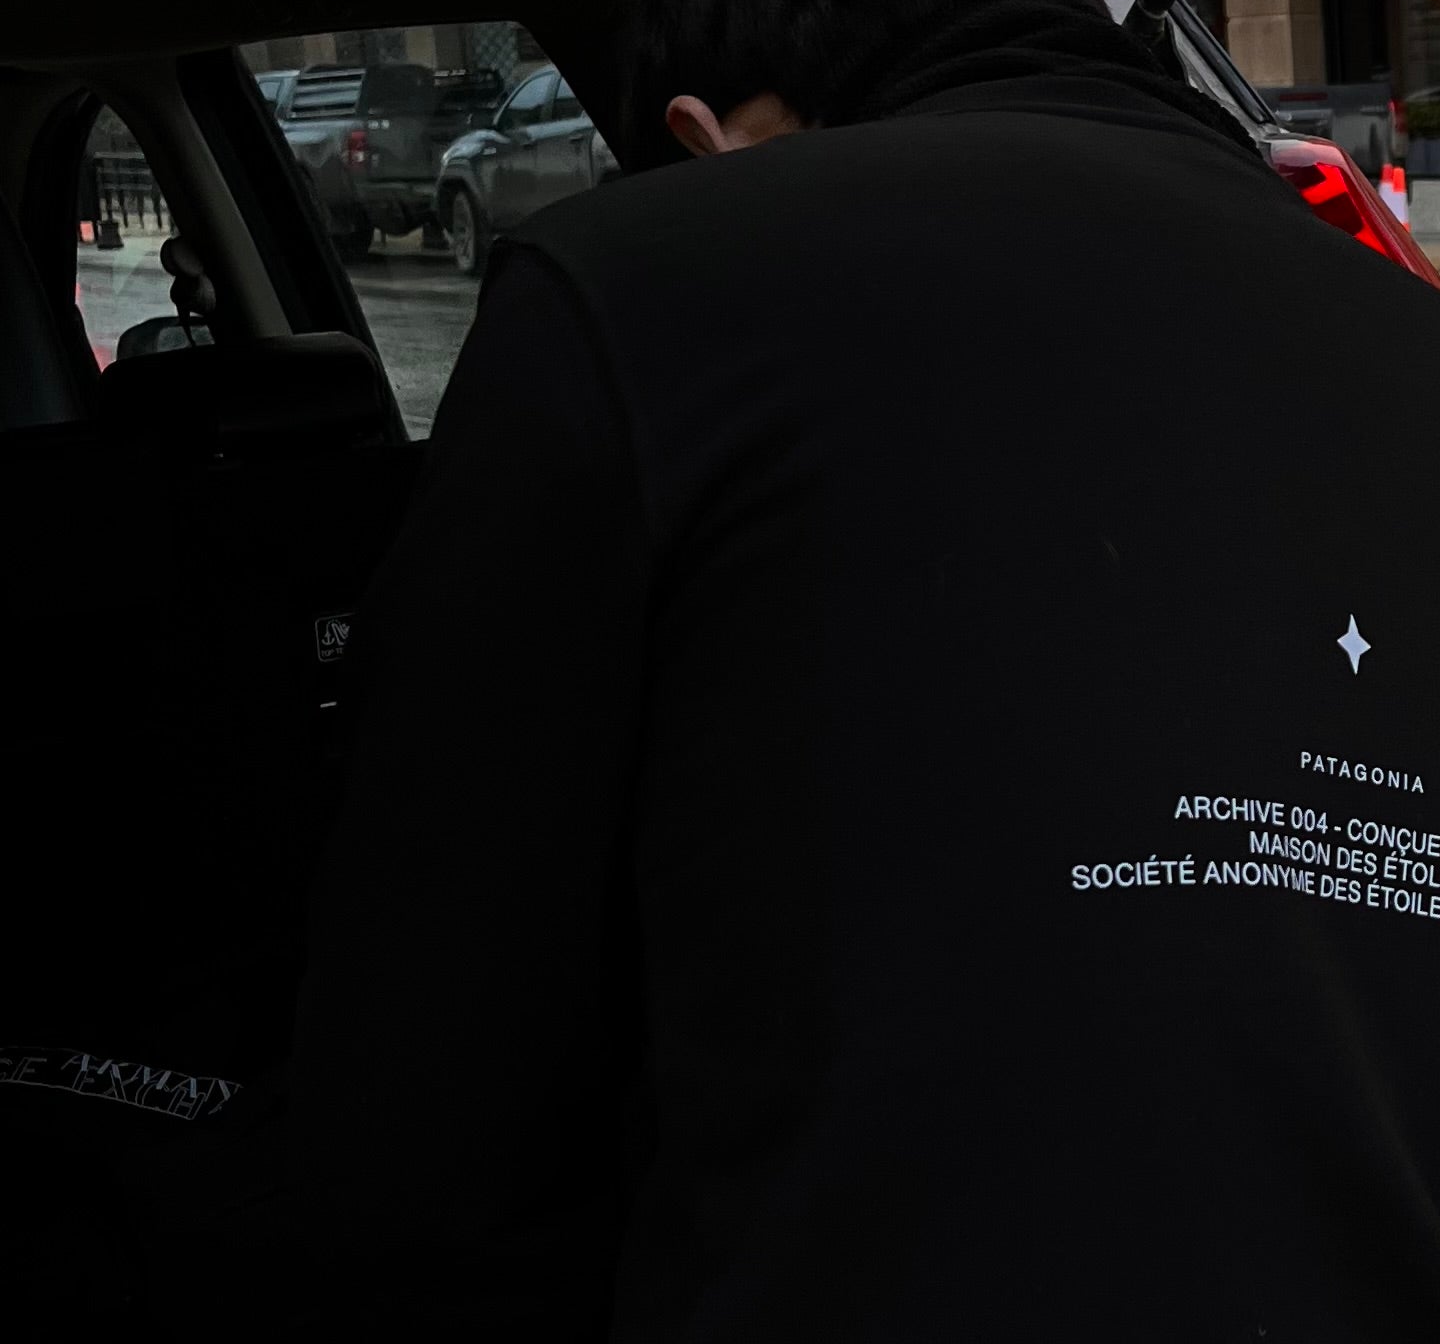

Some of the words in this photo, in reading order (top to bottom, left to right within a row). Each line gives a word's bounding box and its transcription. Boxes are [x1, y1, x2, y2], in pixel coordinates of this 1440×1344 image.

[1300, 751, 1424, 794] PATAGONIA
[1174, 795, 1286, 827] ARCHIVE
[1290, 805, 1329, 835] 004
[1249, 830, 1331, 867] MAISON
[1336, 846, 1378, 876] DES
[1071, 853, 1197, 890] SOCIÉTÉ
[1202, 860, 1316, 895] ANONYME
[1319, 874, 1362, 904] DES
